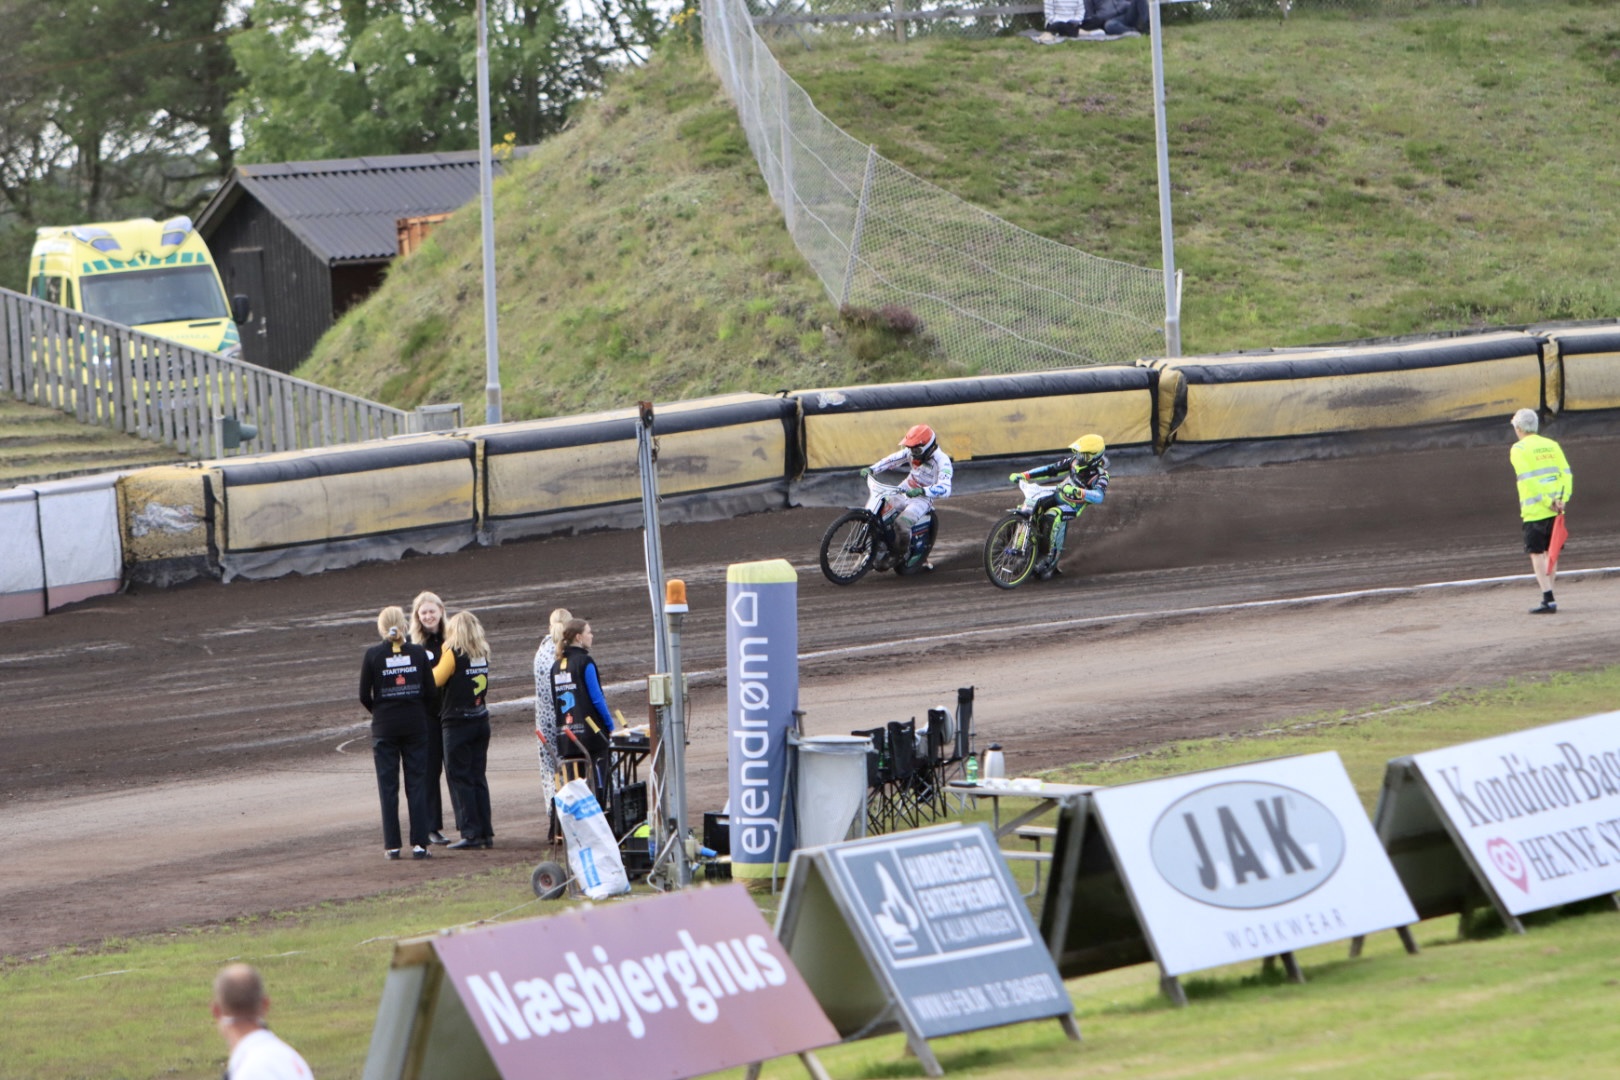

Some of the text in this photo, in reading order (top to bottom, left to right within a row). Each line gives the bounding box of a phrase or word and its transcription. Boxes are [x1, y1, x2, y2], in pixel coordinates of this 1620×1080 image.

[382, 666, 417, 676] STARTPIGER
[732, 636, 779, 855] ejendrøm
[1518, 826, 1609, 881] HENNE
[1223, 907, 1347, 949] WORKWEAR
[465, 929, 787, 1044] Næsbjerghus
